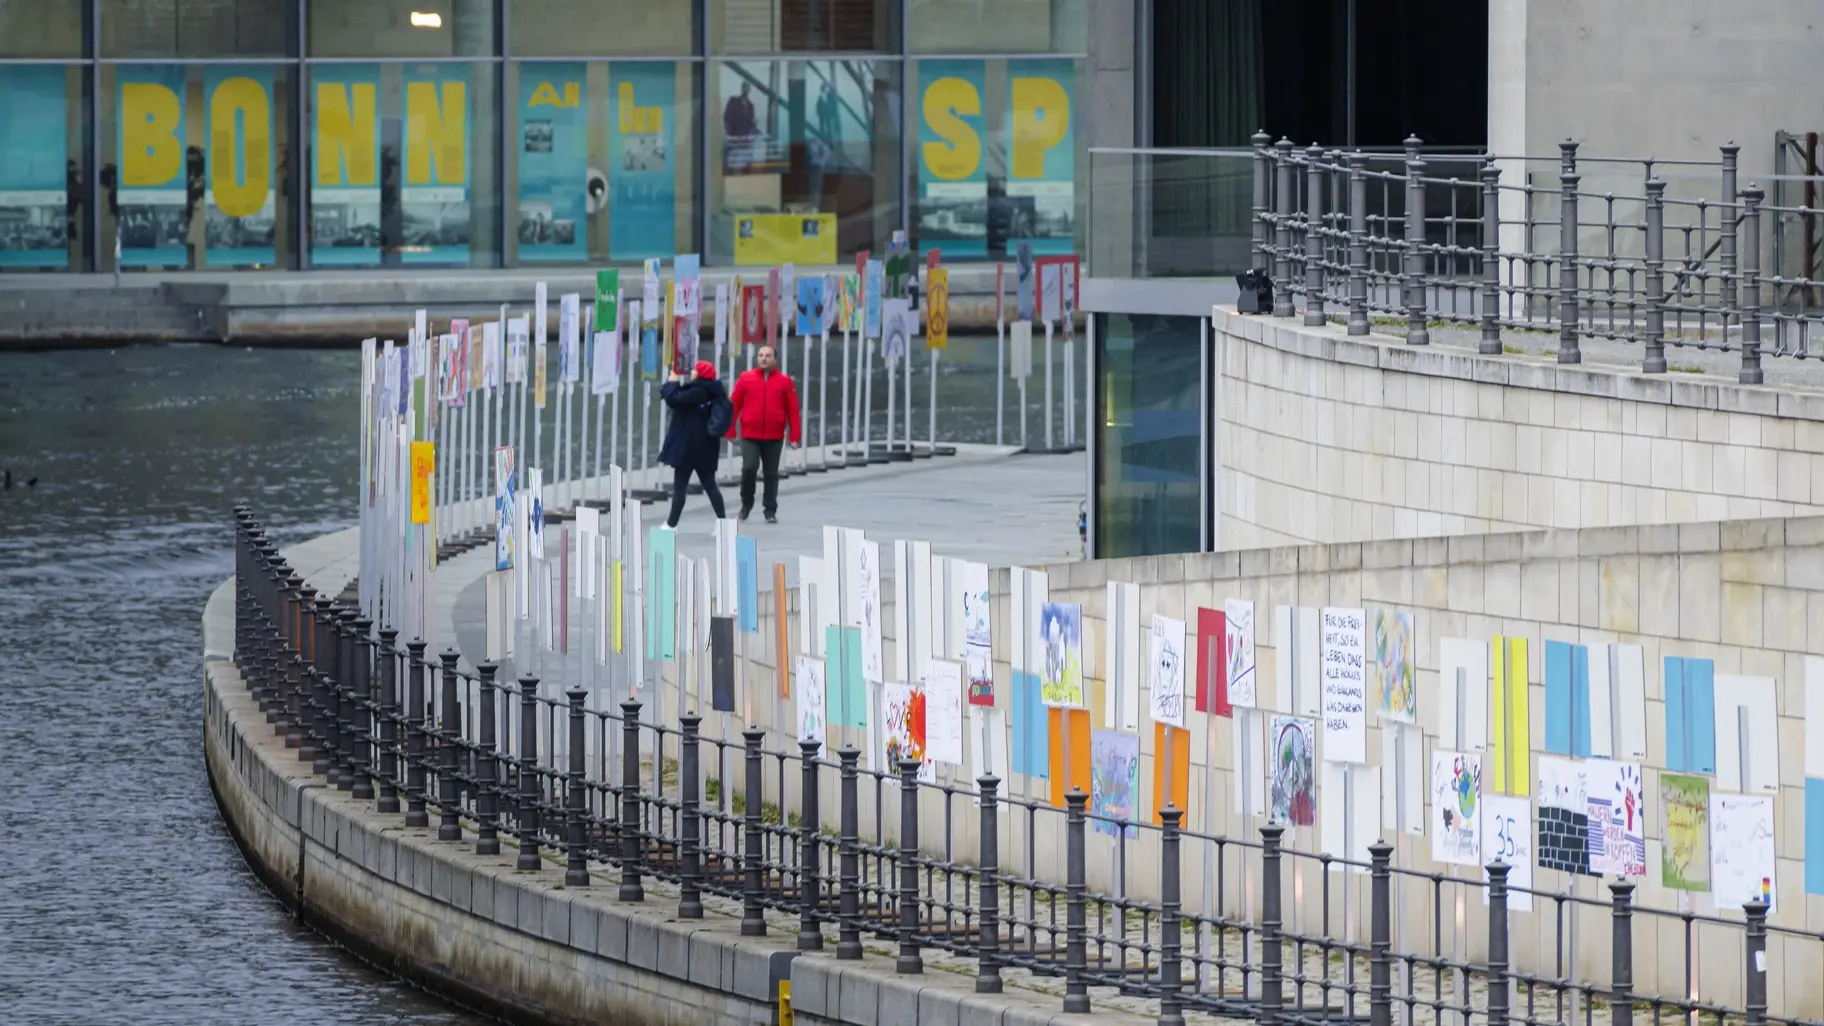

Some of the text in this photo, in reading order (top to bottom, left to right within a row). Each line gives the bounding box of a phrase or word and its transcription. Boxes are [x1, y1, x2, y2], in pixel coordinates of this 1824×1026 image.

[121, 77, 466, 217] BONN
[922, 76, 1070, 181] SP
[1495, 814, 1516, 857] 35
